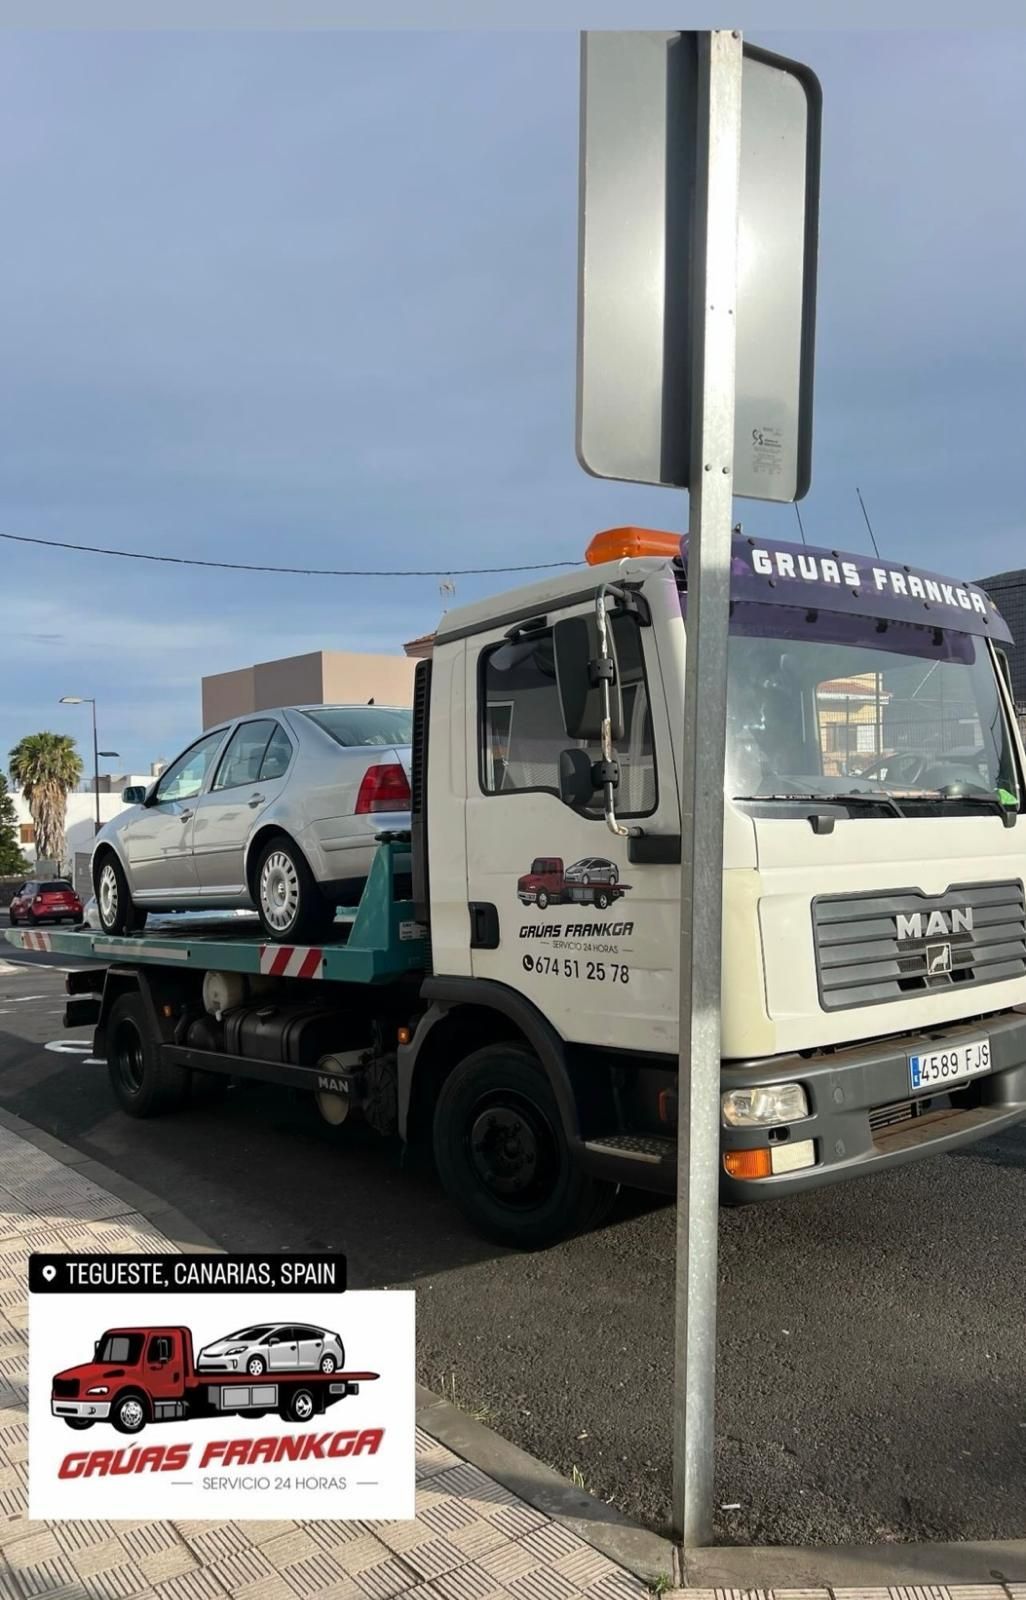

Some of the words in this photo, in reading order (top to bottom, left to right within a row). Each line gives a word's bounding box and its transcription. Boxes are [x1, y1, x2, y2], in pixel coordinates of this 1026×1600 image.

[751, 549, 861, 586] GRUAS
[872, 567, 987, 614] FRANKGA
[519, 923, 561, 938] GRÚAS
[564, 922, 634, 938] FRANKGA
[895, 907, 974, 940] MAN
[552, 941, 582, 951] SERVICIO
[583, 943, 592, 952] 24
[593, 945, 619, 954] HORAS
[535, 956, 559, 976] 674
[564, 959, 579, 979] 51
[586, 961, 605, 981] 25
[611, 964, 630, 984] 78
[921, 1052, 959, 1081] 4589
[965, 1044, 990, 1071] FJS
[318, 1076, 349, 1093] MAN
